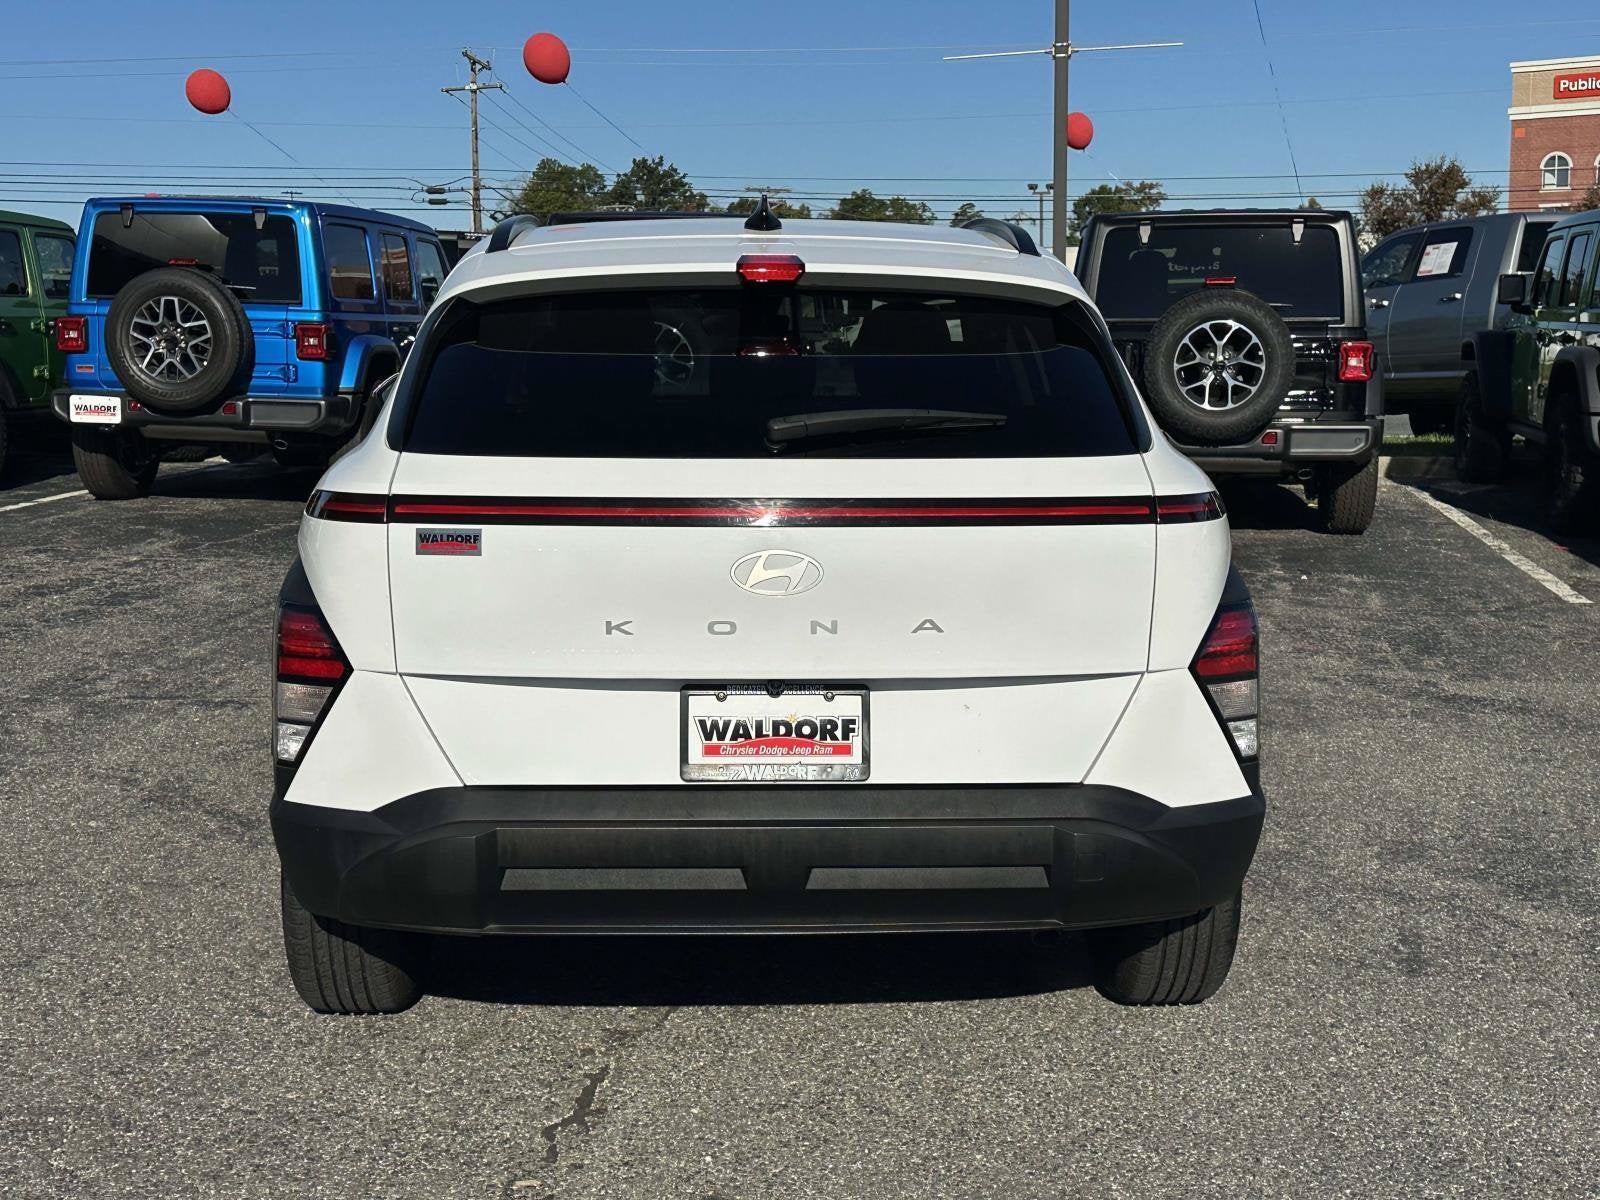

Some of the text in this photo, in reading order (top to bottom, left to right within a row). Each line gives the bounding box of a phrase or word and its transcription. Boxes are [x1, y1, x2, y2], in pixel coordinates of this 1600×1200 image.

[74, 404, 117, 412] WALDORF
[419, 533, 480, 544] WALDORF
[696, 717, 858, 742] WALDORF
[720, 745, 833, 756] Chrysler Dodge Jeep Ram
